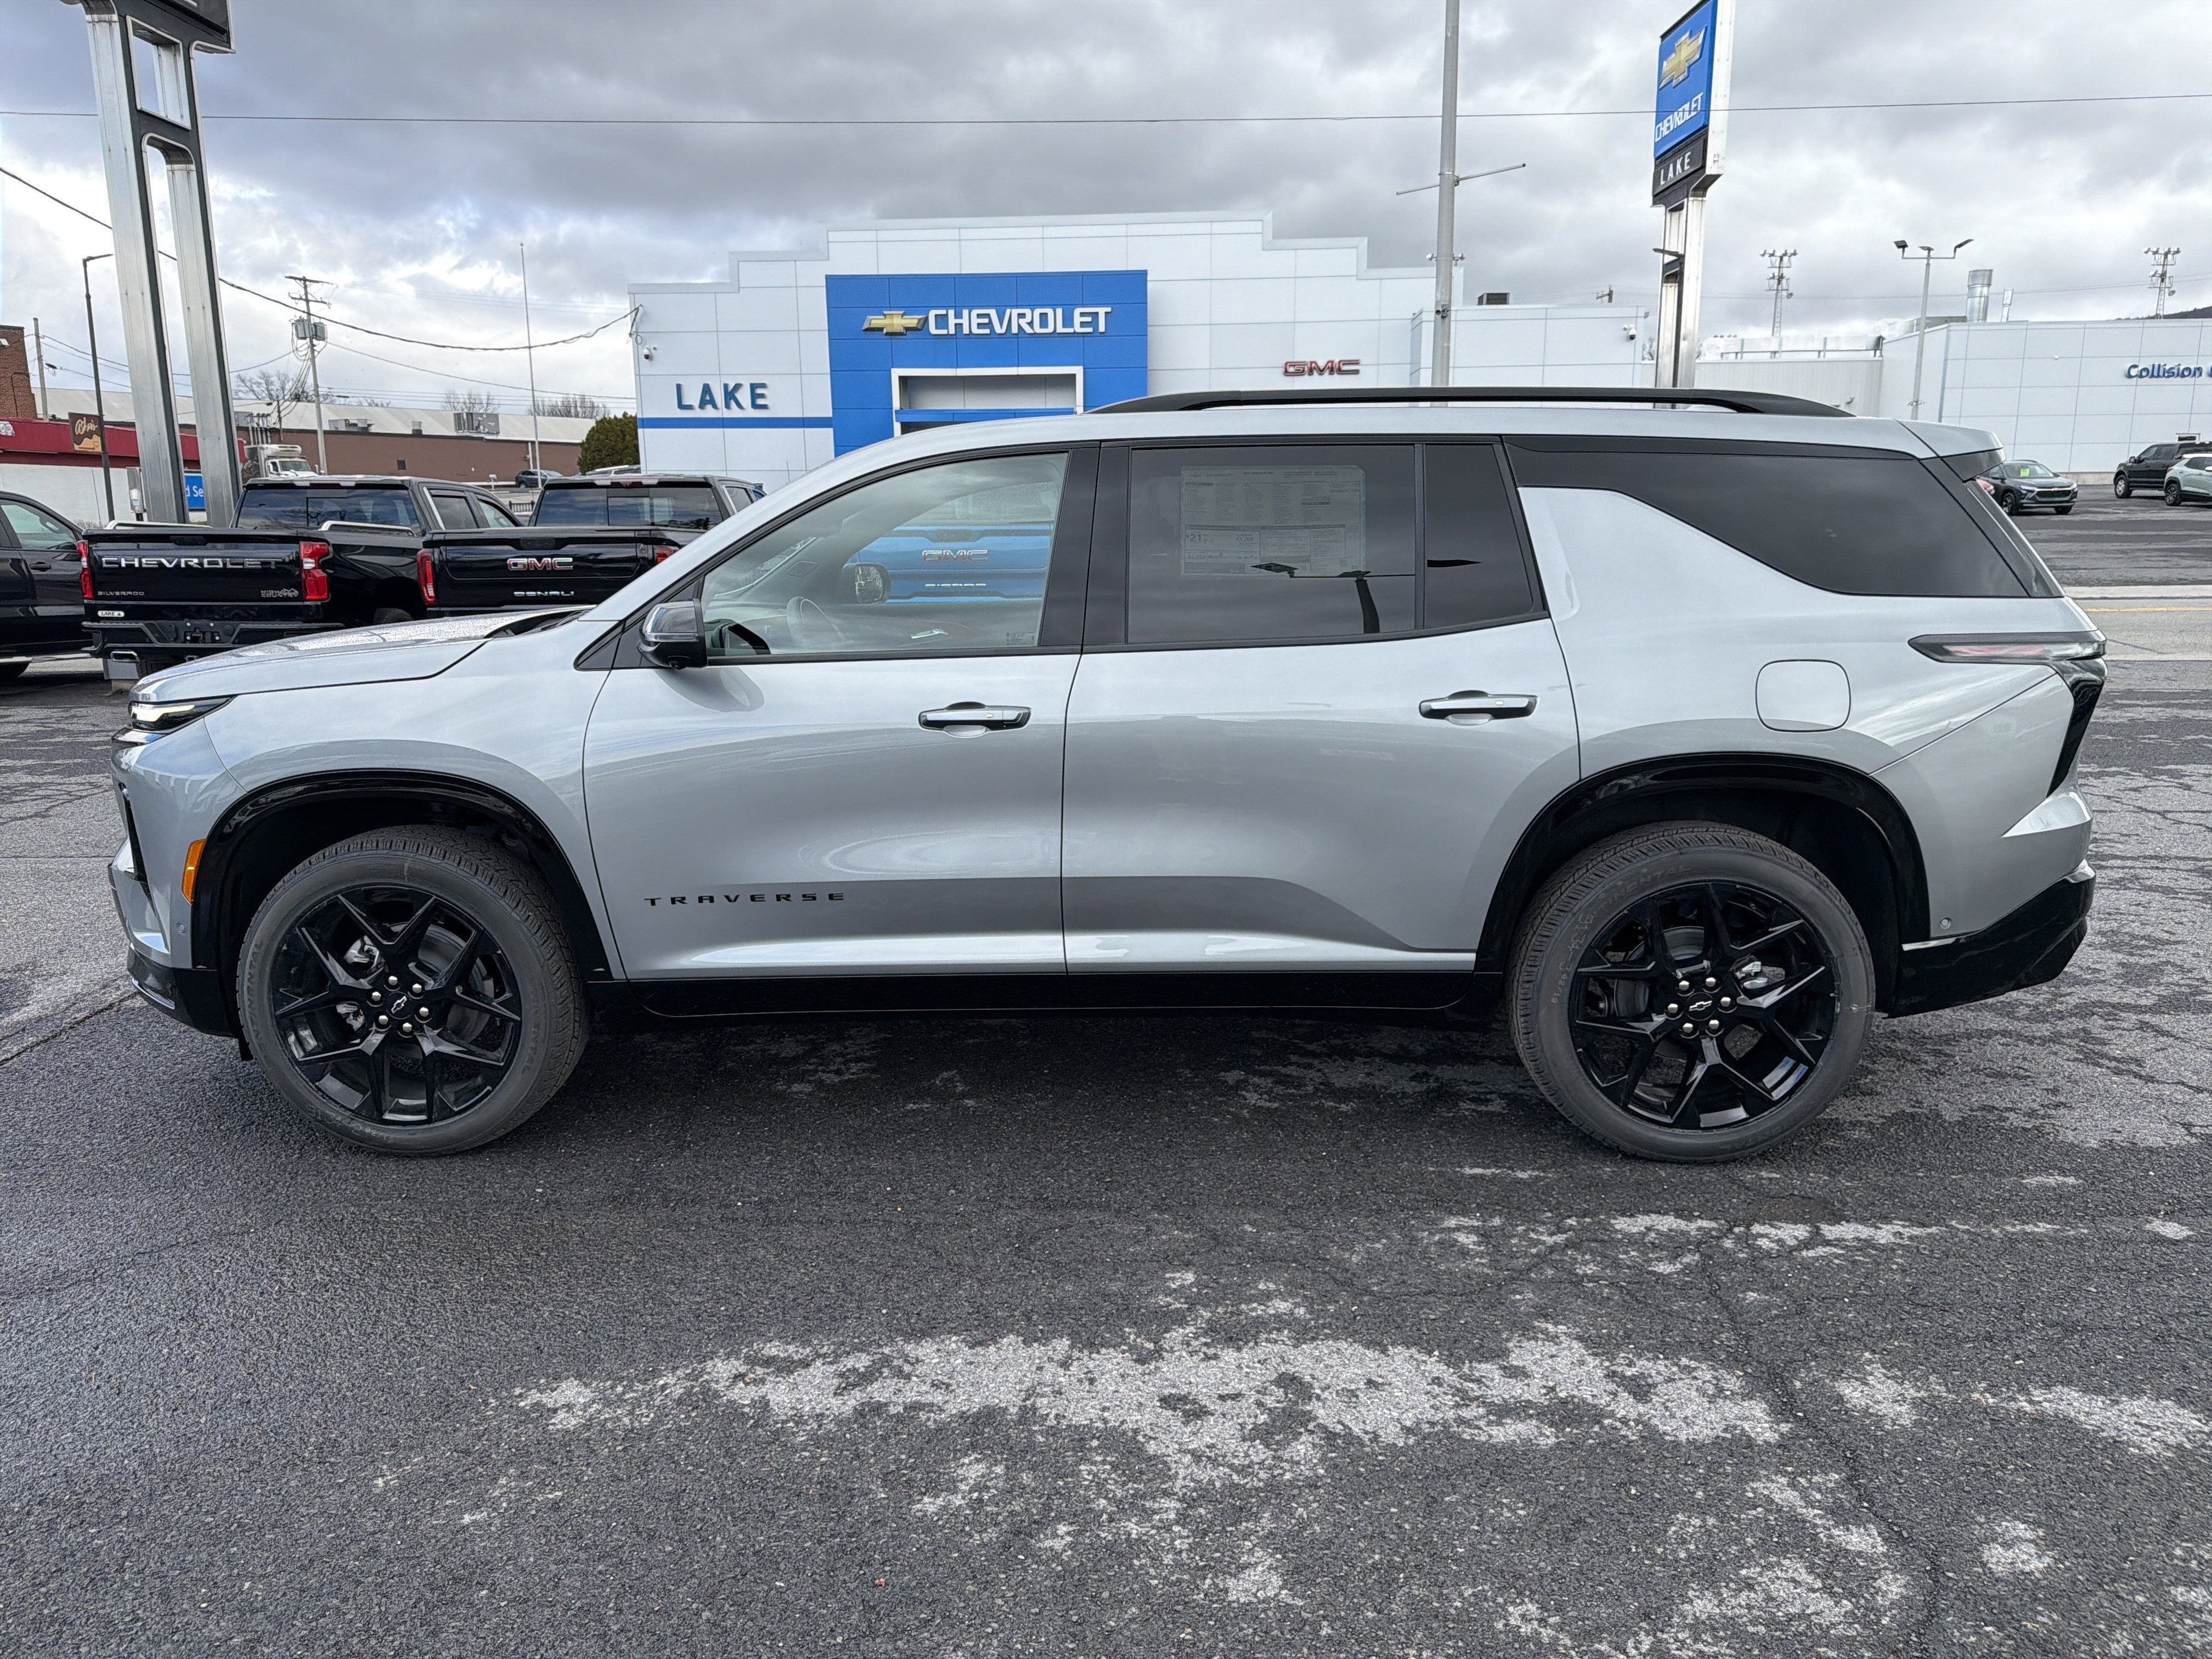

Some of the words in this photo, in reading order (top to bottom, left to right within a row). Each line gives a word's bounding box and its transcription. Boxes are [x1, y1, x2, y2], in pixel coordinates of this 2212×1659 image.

[1655, 92, 1703, 143] CHEVROLET
[1660, 151, 1691, 185] LAKE
[928, 307, 1112, 335] CHEVROLET
[1283, 359, 1361, 376] GMC
[2125, 363, 2203, 379] Collision
[676, 382, 769, 410] LAKE
[101, 557, 284, 569] CHEVROLET
[507, 557, 573, 571] GMC
[922, 550, 988, 563] GMC
[644, 891, 844, 907] TRAVERSE
